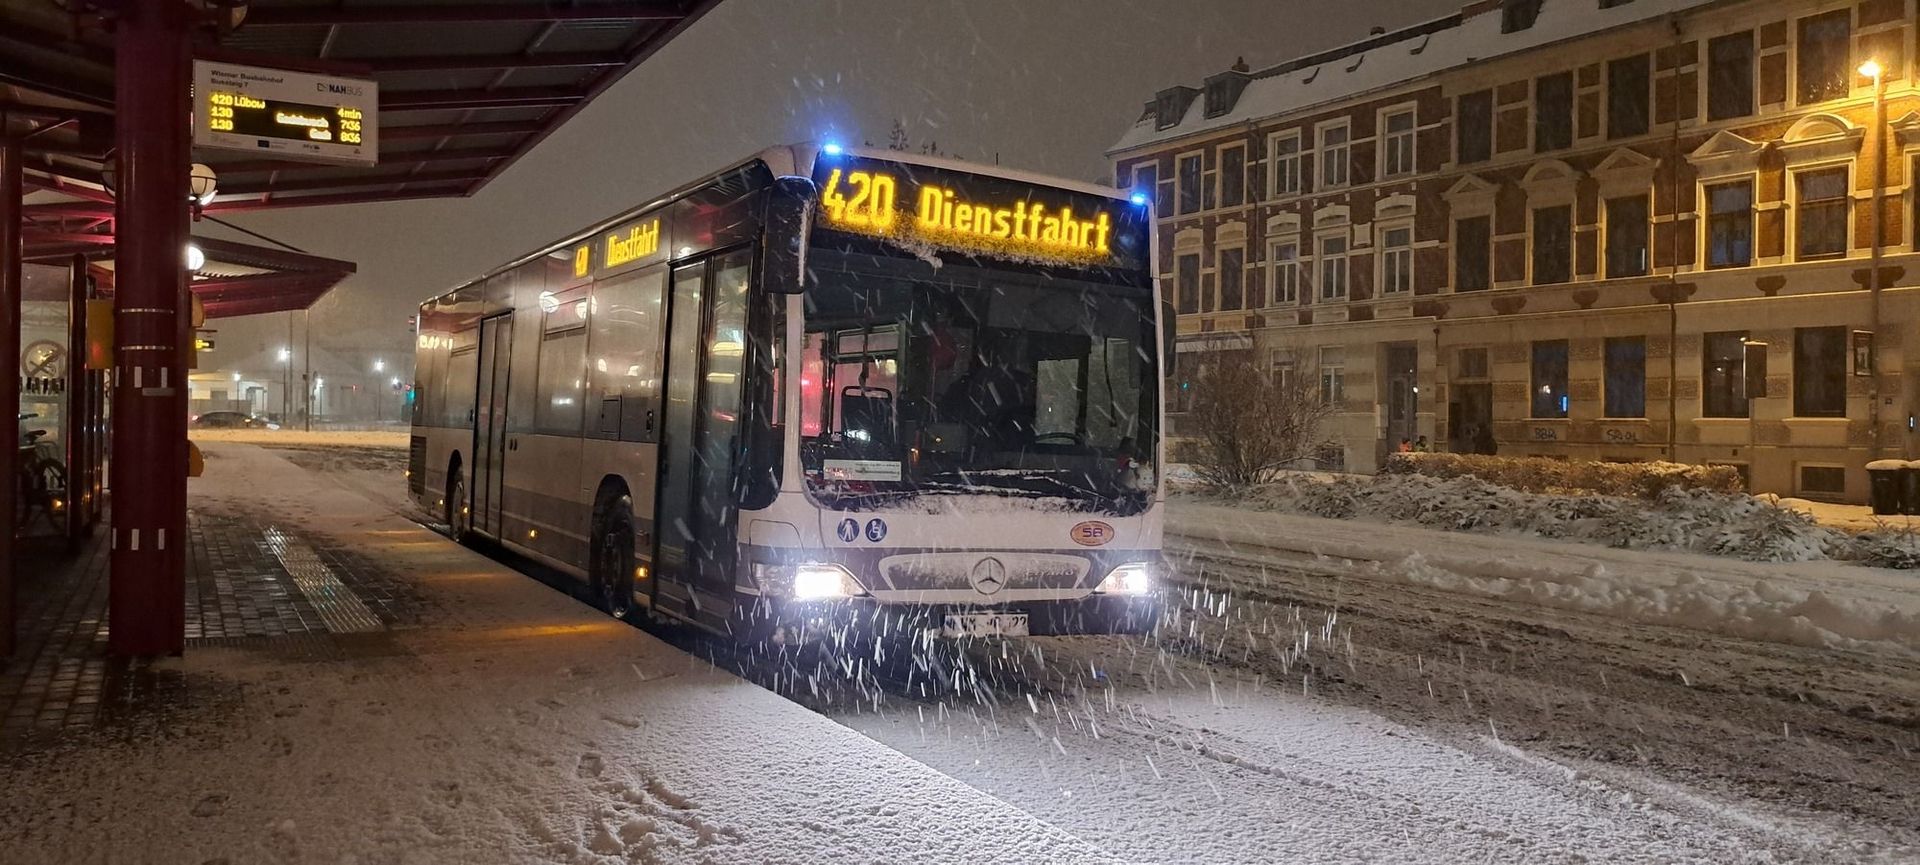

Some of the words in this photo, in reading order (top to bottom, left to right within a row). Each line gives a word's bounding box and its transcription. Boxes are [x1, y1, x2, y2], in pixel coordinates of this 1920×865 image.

[240, 73, 284, 84] Busbahnhof
[211, 94, 233, 106] 420
[210, 106, 233, 118] 130
[210, 119, 233, 131] 130
[822, 168, 896, 228] 420
[920, 186, 1110, 252] Dienstfahrt
[607, 219, 660, 267] Dienstfahrt
